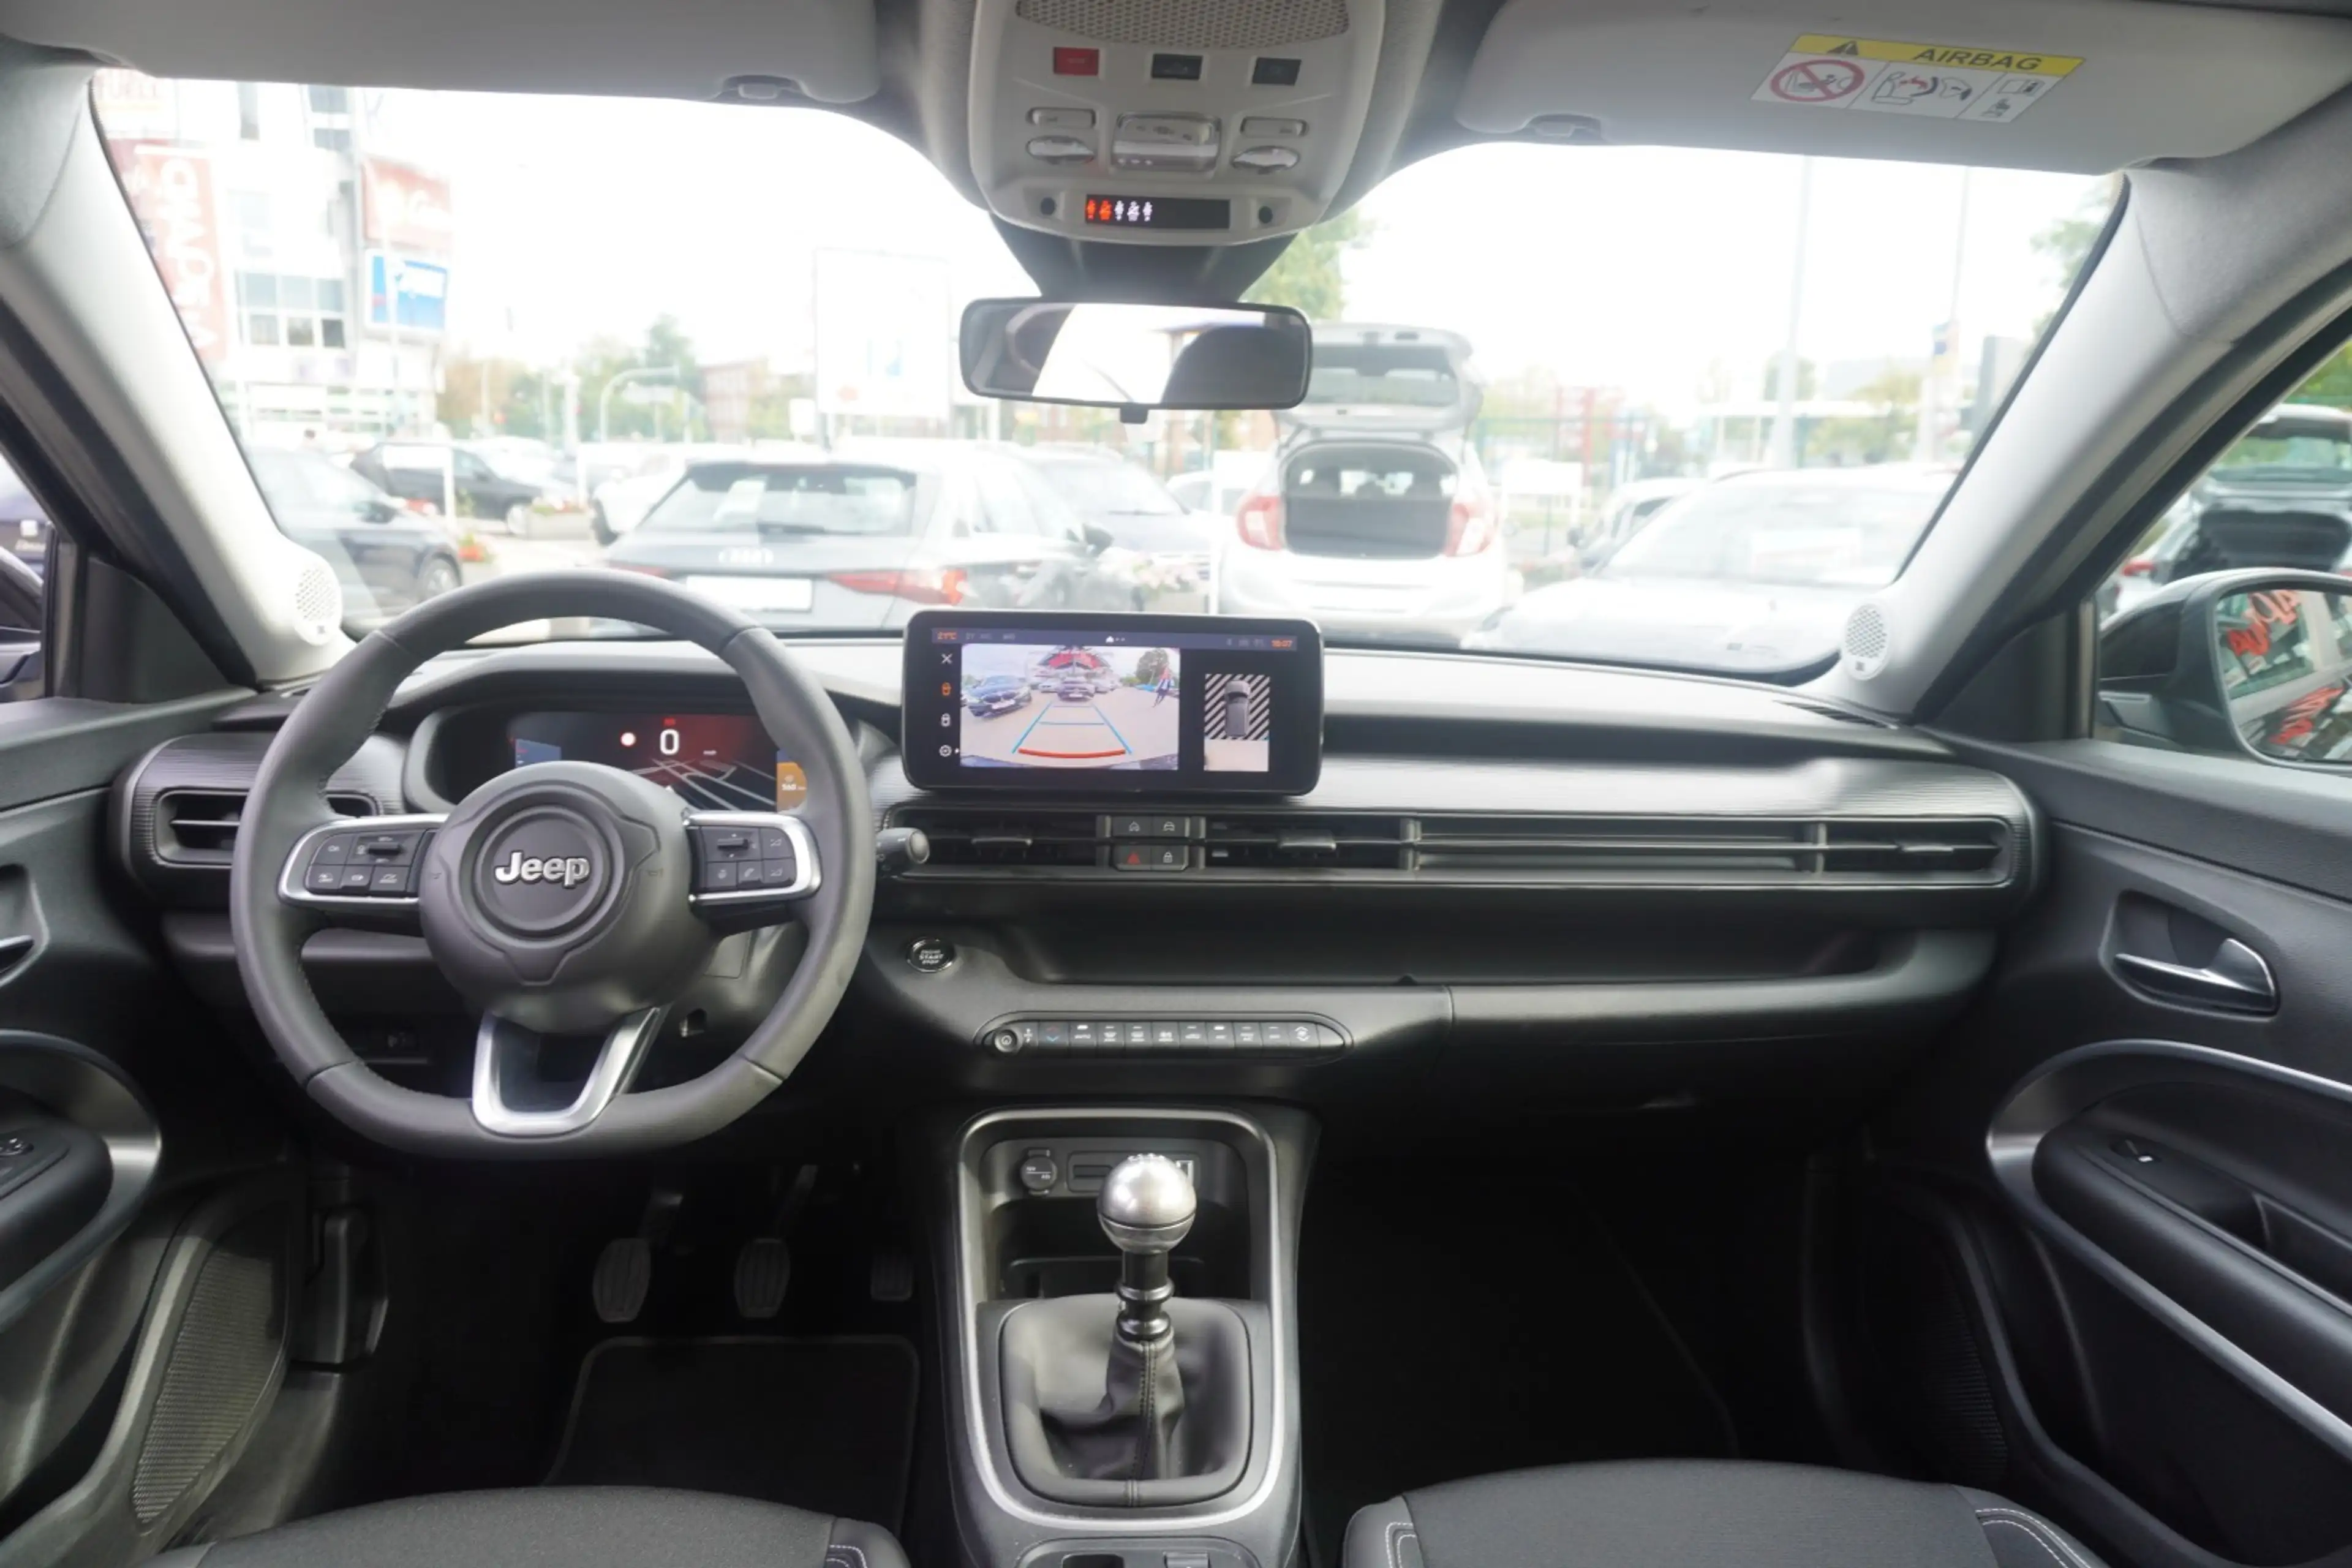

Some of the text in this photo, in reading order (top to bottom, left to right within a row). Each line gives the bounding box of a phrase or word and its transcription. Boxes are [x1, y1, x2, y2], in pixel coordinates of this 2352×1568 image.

[1912, 48, 2042, 70] AIRBAG
[660, 728, 680, 756] 0
[494, 851, 590, 886] Jeep
